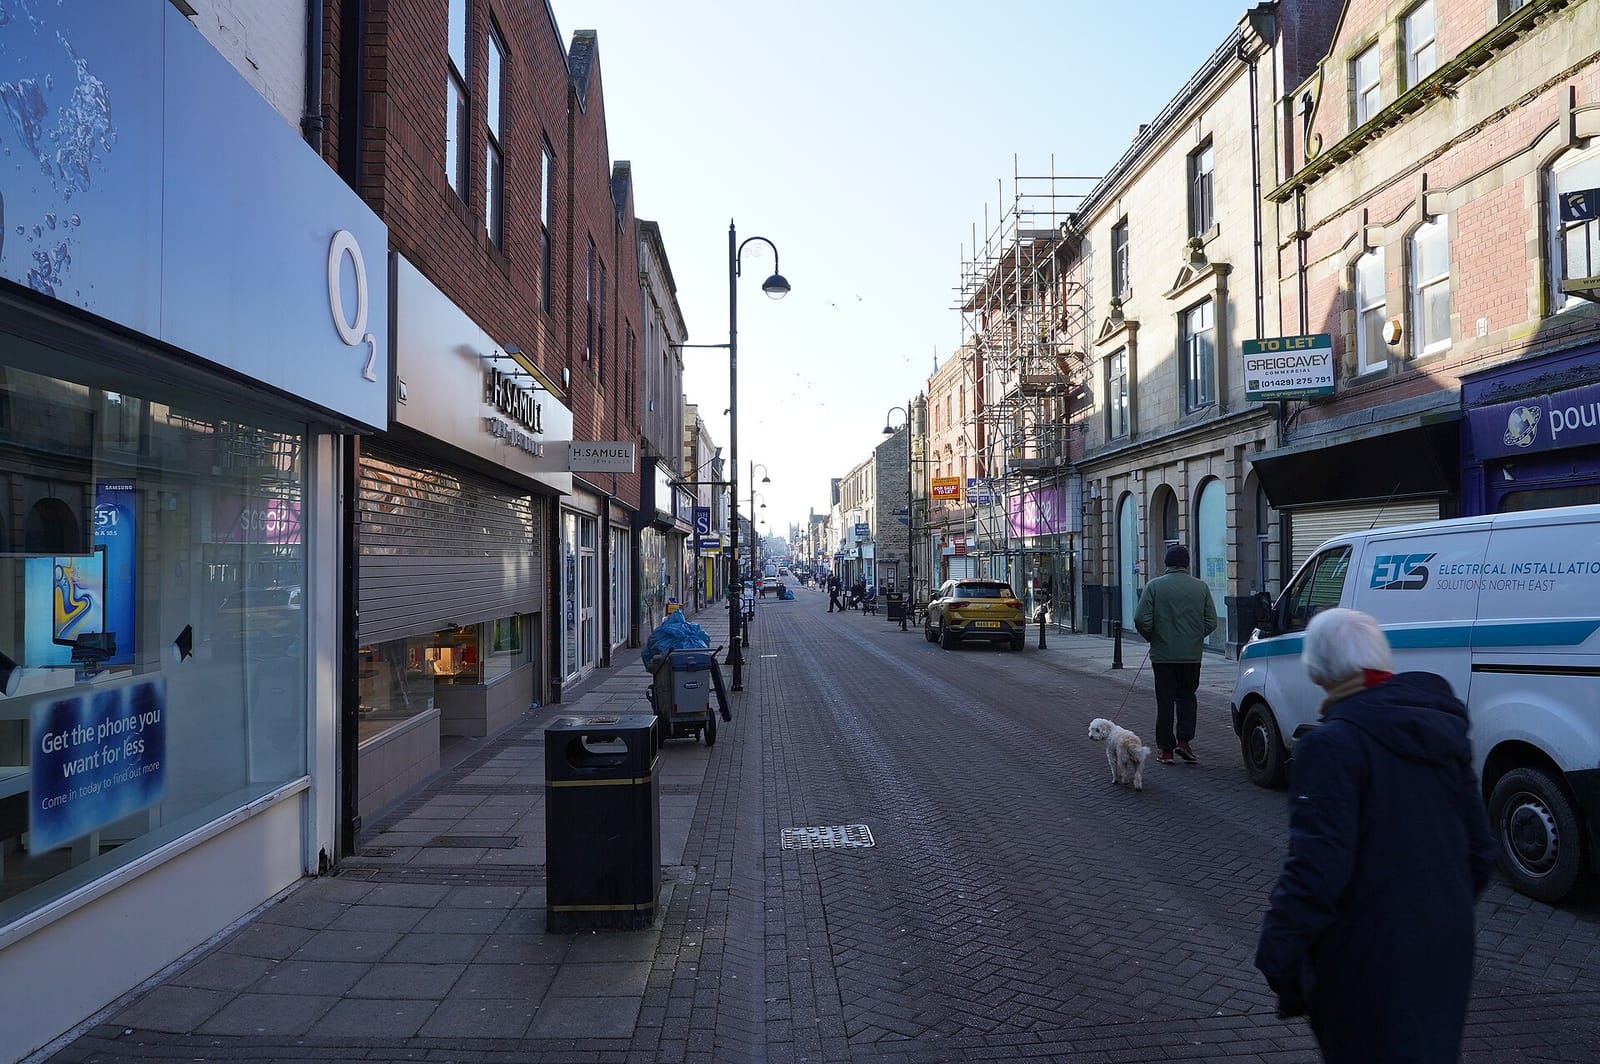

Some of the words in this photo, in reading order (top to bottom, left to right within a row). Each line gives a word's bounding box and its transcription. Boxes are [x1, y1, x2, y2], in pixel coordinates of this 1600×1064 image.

[328, 229, 377, 382] O2
[1258, 341, 1280, 352] TO
[1285, 337, 1315, 349] LET
[1247, 354, 1329, 371] GREIGCAVEY
[1264, 368, 1311, 376] COMMERCIAL
[1296, 377, 1313, 385] 275
[1315, 375, 1331, 383] 791
[1549, 402, 1600, 440] pou
[573, 448, 630, 458] H.SAMUEL
[697, 517, 708, 534] S
[1370, 552, 1437, 590] ETS
[1439, 563, 1507, 575] ELECTRICAL
[1436, 579, 1486, 590] SOLUTIONS
[1488, 580, 1525, 590] NORTH
[1528, 579, 1556, 591] EAST
[41, 731, 69, 754] Get
[71, 724, 95, 747] the
[97, 716, 137, 745] phone
[139, 708, 161, 733] you
[63, 750, 100, 778] want
[101, 744, 121, 766] for
[123, 738, 145, 760] less
[41, 794, 68, 810] Come
[69, 788, 78, 801] in
[80, 780, 102, 797] today
[103, 777, 112, 788] to
[113, 768, 128, 785] find
[129, 767, 142, 780] out
[142, 761, 160, 774] more
